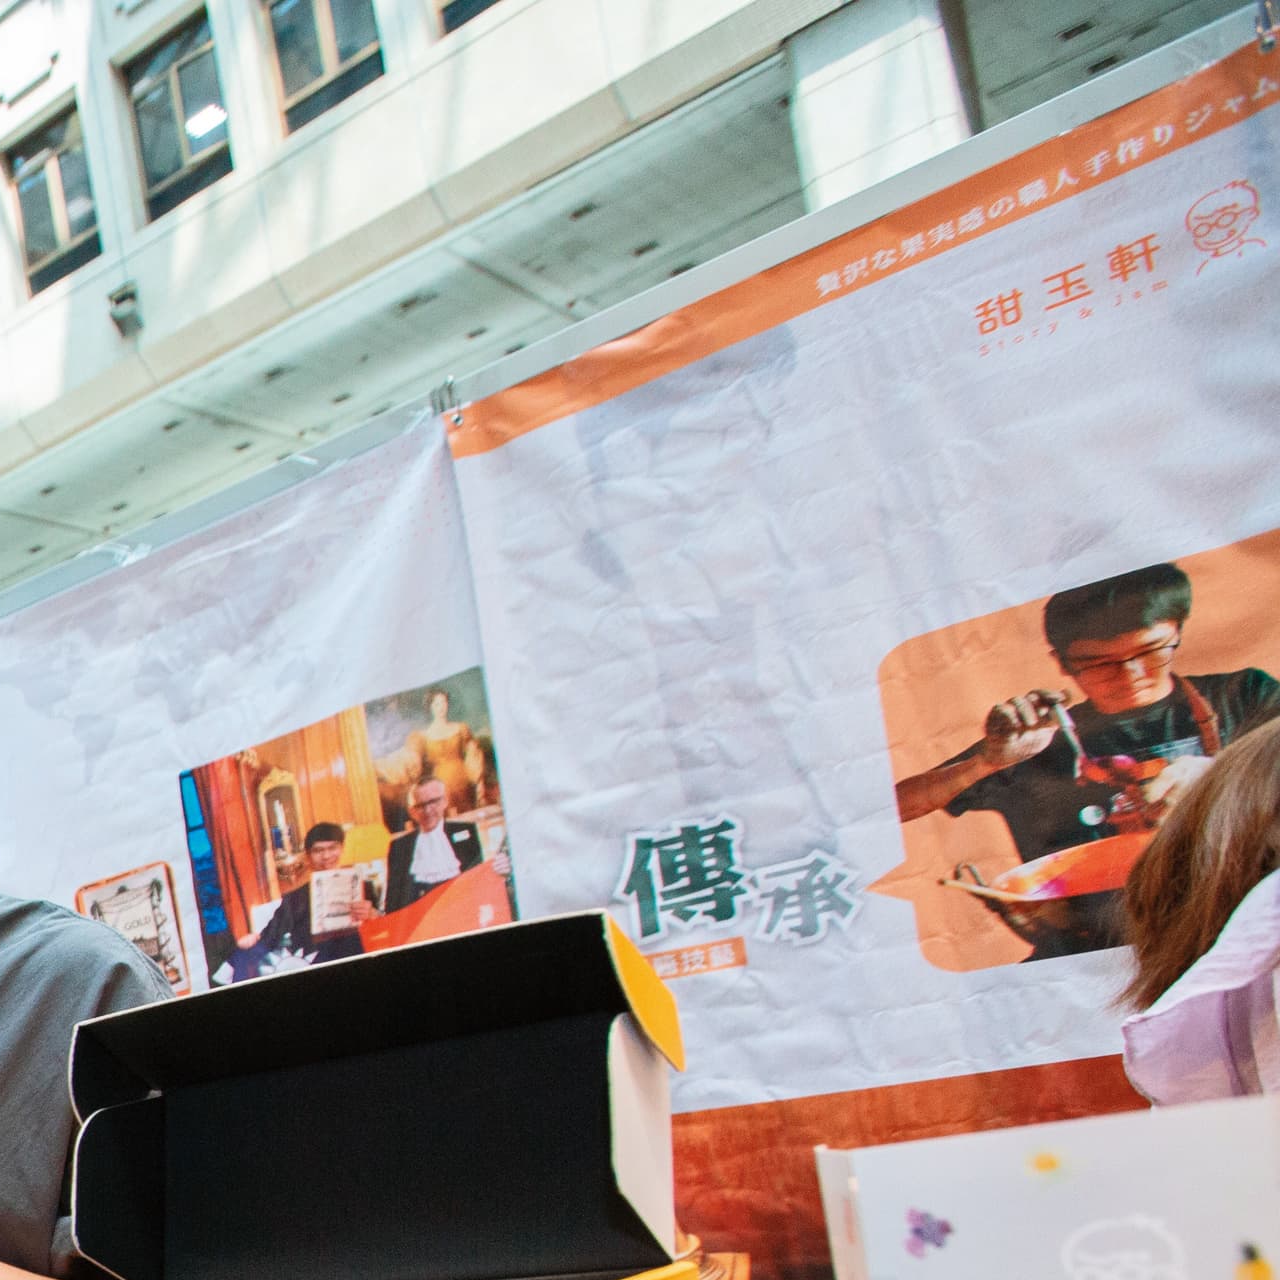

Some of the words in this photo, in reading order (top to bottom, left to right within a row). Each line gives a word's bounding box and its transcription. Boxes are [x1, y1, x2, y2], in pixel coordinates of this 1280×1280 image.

[975, 232, 1161, 335] 甜玉軒
[622, 818, 854, 941] 傳承
